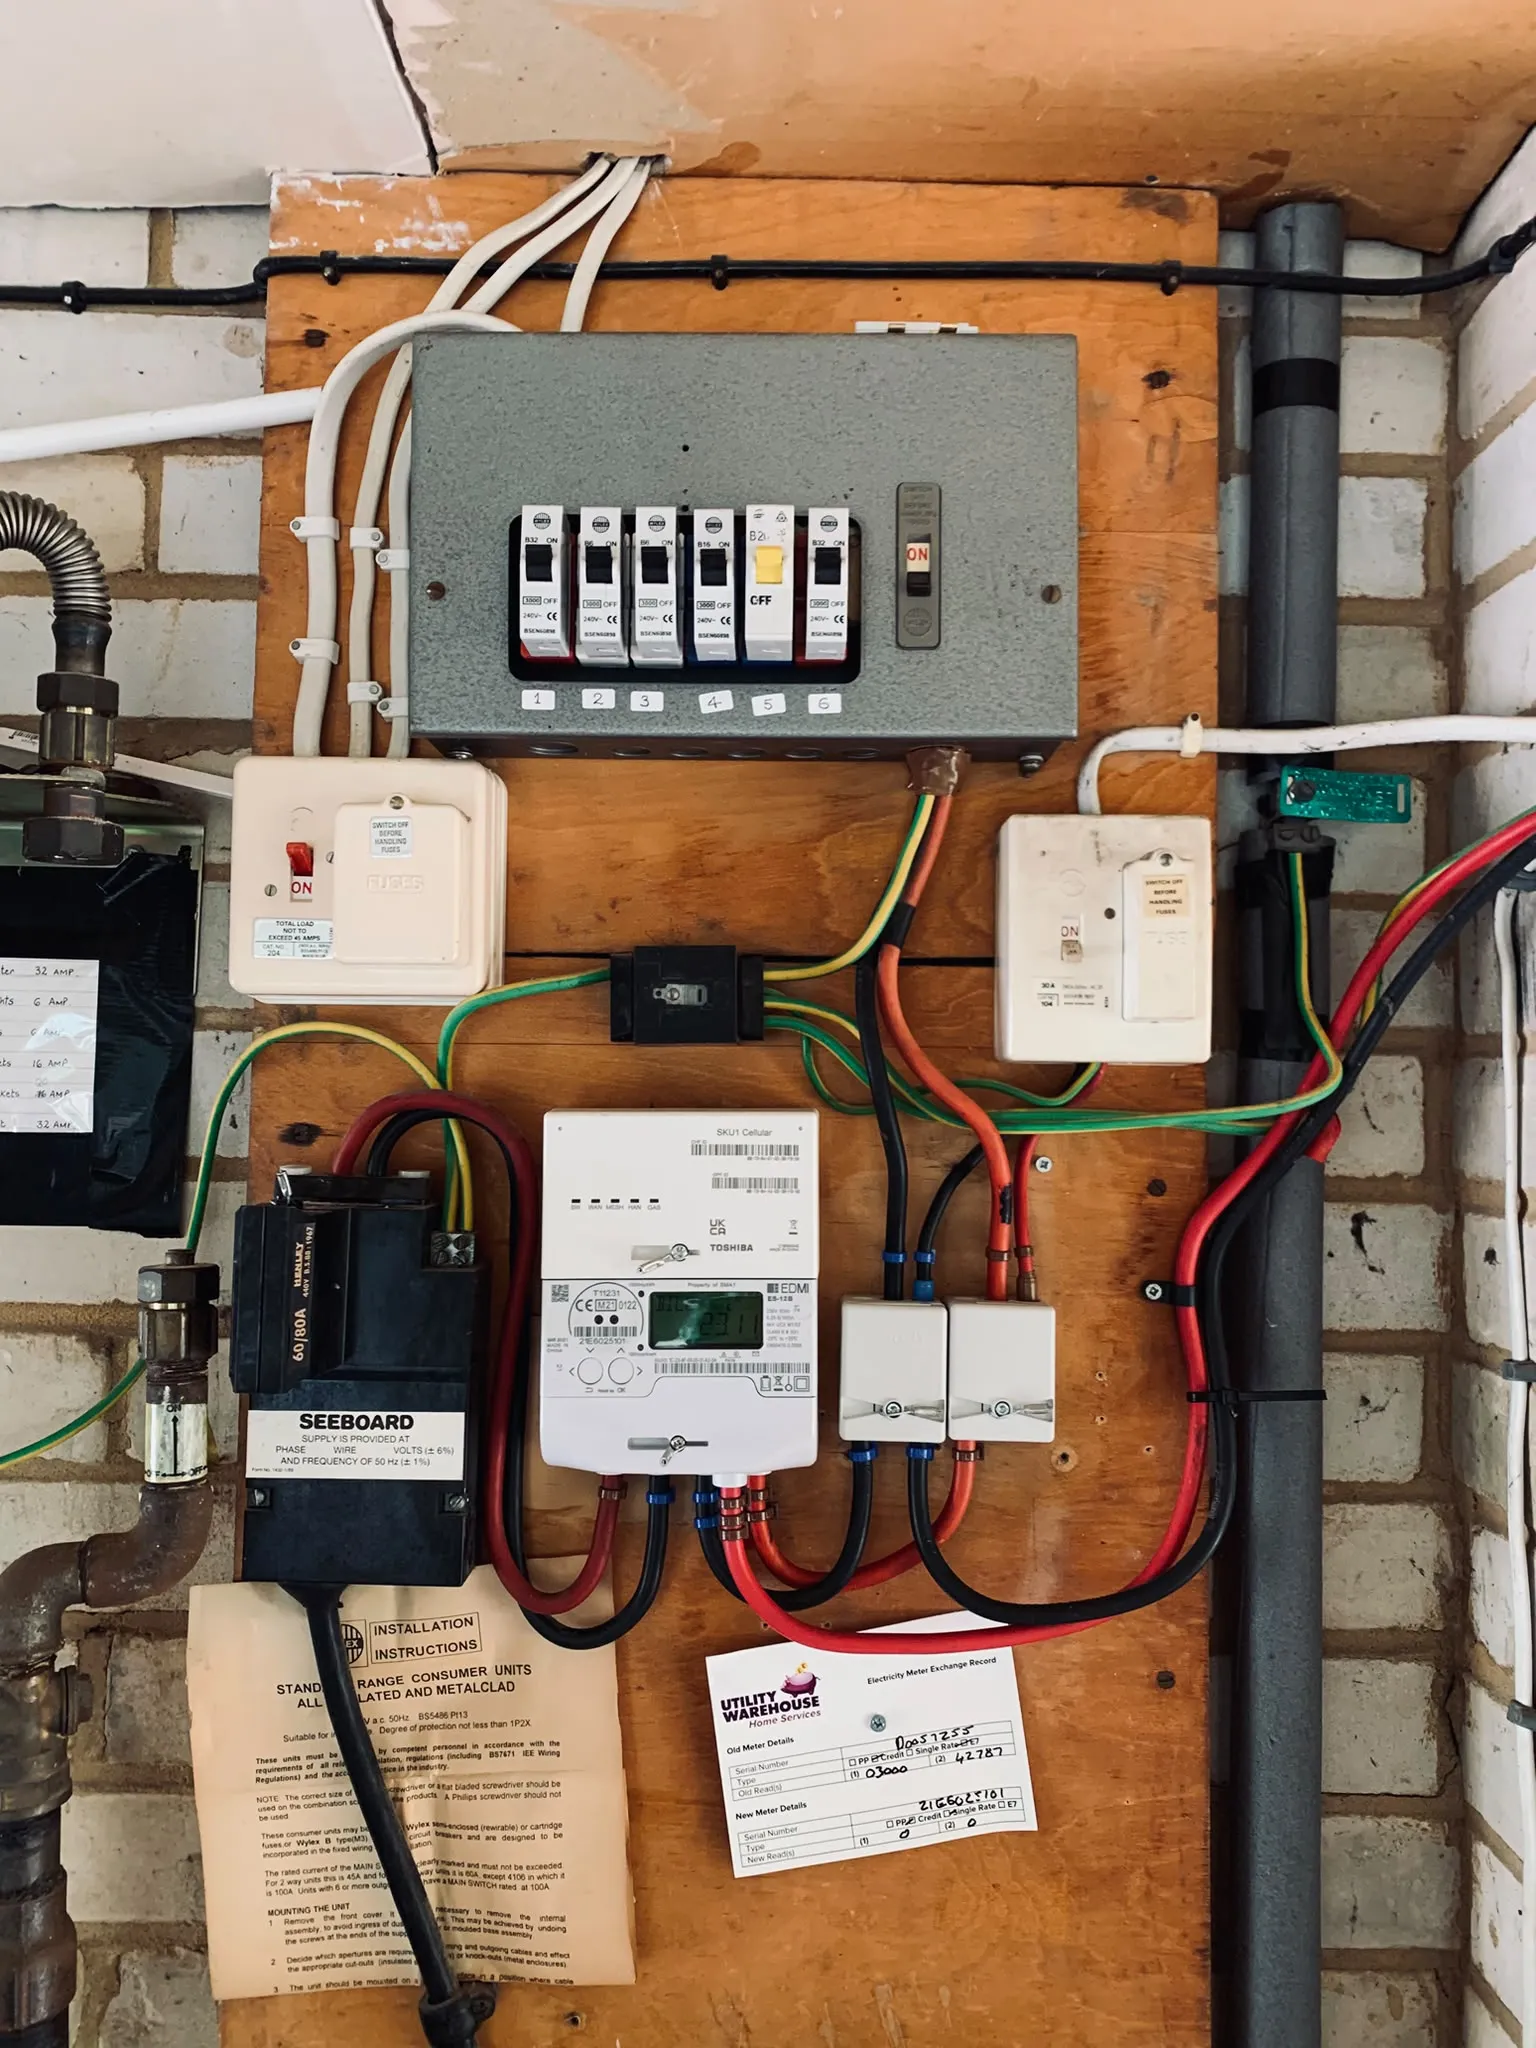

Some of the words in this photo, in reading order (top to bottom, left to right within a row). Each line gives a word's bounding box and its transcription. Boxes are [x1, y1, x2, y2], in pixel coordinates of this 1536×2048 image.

[907, 548, 928, 560] ON
[750, 596, 771, 605] OFF
[534, 693, 541, 704] 1
[594, 693, 603, 705] 2
[640, 696, 649, 707] 3
[708, 696, 722, 707] 4
[764, 699, 773, 710] 5
[819, 698, 829, 709] 6
[291, 882, 312, 894] ON
[1061, 926, 1078, 936] ON
[35, 967, 47, 976] 32
[34, 998, 40, 1006] 6
[33, 1060, 42, 1068] 16
[37, 1120, 50, 1128] 32
[294, 1242, 304, 1287] HENLEY
[781, 1283, 809, 1293] EDMI
[619, 1301, 636, 1310] 0122
[293, 1308, 308, 1361] 60/80A
[300, 1413, 414, 1430] SEEBOARD
[302, 1435, 337, 1443] SUPPLY
[350, 1435, 396, 1443] PROVIDED
[276, 1446, 306, 1454] PHASE
[334, 1446, 356, 1454] WIRE
[393, 1447, 422, 1455] VOLTS
[281, 1457, 300, 1465] AND
[302, 1458, 358, 1466] FREQUENCY
[375, 1458, 385, 1466] 50
[387, 1458, 399, 1466] Hz
[374, 1617, 473, 1636] INSTALLATION
[375, 1639, 477, 1660] INSTRUCTIONS
[357, 1676, 404, 1689] RANGE
[411, 1667, 487, 1683] CONSUMER
[495, 1665, 532, 1676] UNITS
[867, 1672, 904, 1684] Electricity
[906, 1667, 928, 1677] Meter
[930, 1661, 968, 1673] Exchange
[969, 1657, 996, 1666] Record
[297, 1699, 323, 1709] ALL
[405, 1686, 432, 1698] AND
[436, 1681, 515, 1696] METALCLAD
[721, 1691, 777, 1711] UTILITY
[723, 1696, 819, 1722] WAREHOUSE
[749, 1719, 778, 1728] Home
[781, 1710, 821, 1723] Services
[283, 1733, 315, 1743] Suitable
[379, 1726, 408, 1735] Degree
[410, 1724, 417, 1732] of
[419, 1722, 457, 1733] protection
[458, 1722, 470, 1730] not
[473, 1721, 488, 1729] less
[490, 1720, 508, 1728] than
[727, 1747, 740, 1755] Old
[742, 1742, 765, 1752] Meter
[768, 1737, 794, 1747] Details
[538, 1749, 560, 1758] Wiring
[858, 1757, 869, 1765] PP
[881, 1751, 904, 1762] Credit
[916, 1745, 940, 1755] Single
[735, 1766, 757, 1775] Serial
[759, 1760, 788, 1771] Number
[866, 1765, 908, 1778] 03000
[935, 1755, 945, 1764] (2)
[956, 1747, 1002, 1764] 42787
[482, 1781, 523, 1789] screwdriver
[526, 1780, 550, 1788] should
[737, 1777, 756, 1786] Type
[738, 1789, 752, 1797] Old
[754, 1783, 782, 1794] Read(s)
[736, 1812, 753, 1820] New
[756, 1807, 778, 1816] Meter
[780, 1802, 807, 1812] Details
[896, 1818, 906, 1826] PP
[918, 1812, 941, 1822] Credit
[978, 1803, 996, 1811] Rate
[744, 1833, 766, 1842] Serial
[768, 1826, 798, 1838] Number
[900, 1829, 910, 1839] 0
[945, 1821, 955, 1830] (2)
[967, 1819, 976, 1827] 0
[746, 1843, 765, 1852] Type
[748, 1854, 765, 1864] New
[767, 1850, 795, 1860] Read(s)
[268, 1906, 311, 1917] MOUNTING
[314, 1904, 330, 1913] THE
[332, 1903, 350, 1911] UNIT
